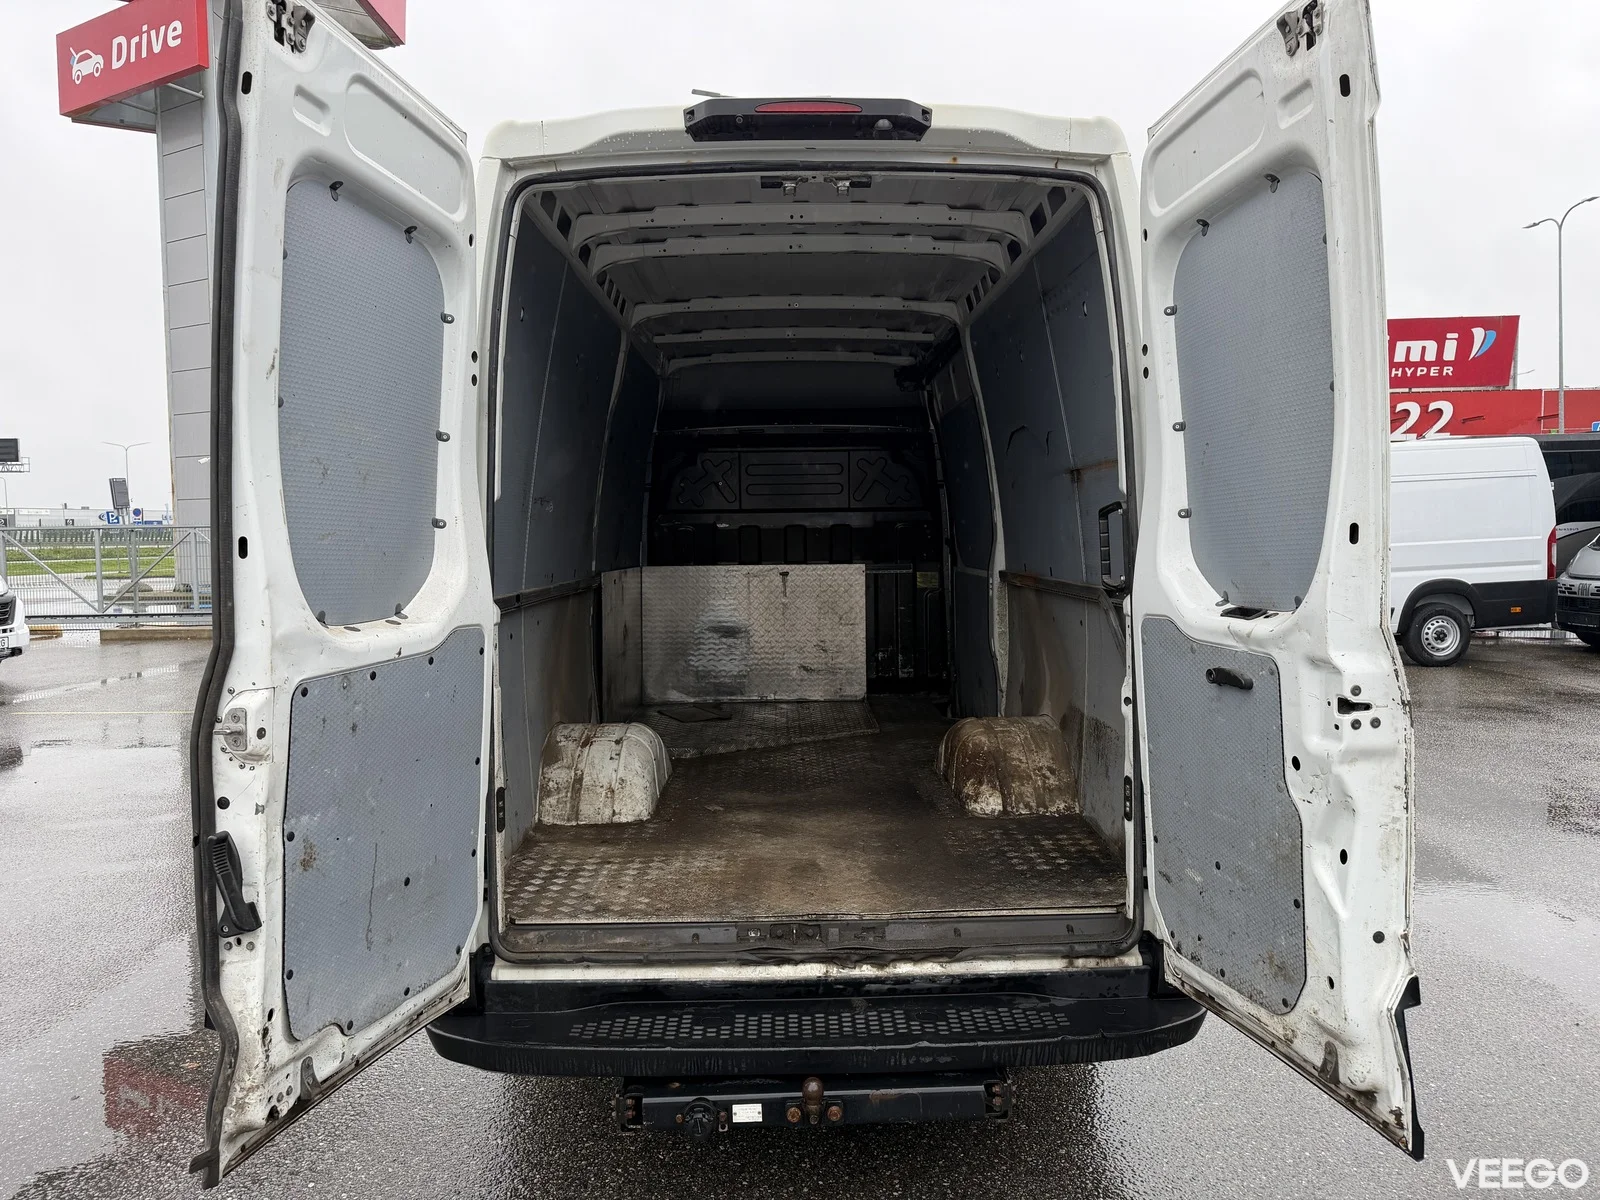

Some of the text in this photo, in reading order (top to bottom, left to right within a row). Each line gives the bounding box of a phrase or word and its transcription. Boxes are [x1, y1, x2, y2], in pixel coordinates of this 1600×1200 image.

[111, 20, 183, 70] Drive
[1388, 333, 1459, 363] mi
[1391, 366, 1454, 378] HYPER
[1577, 582, 1592, 597] FIAT
